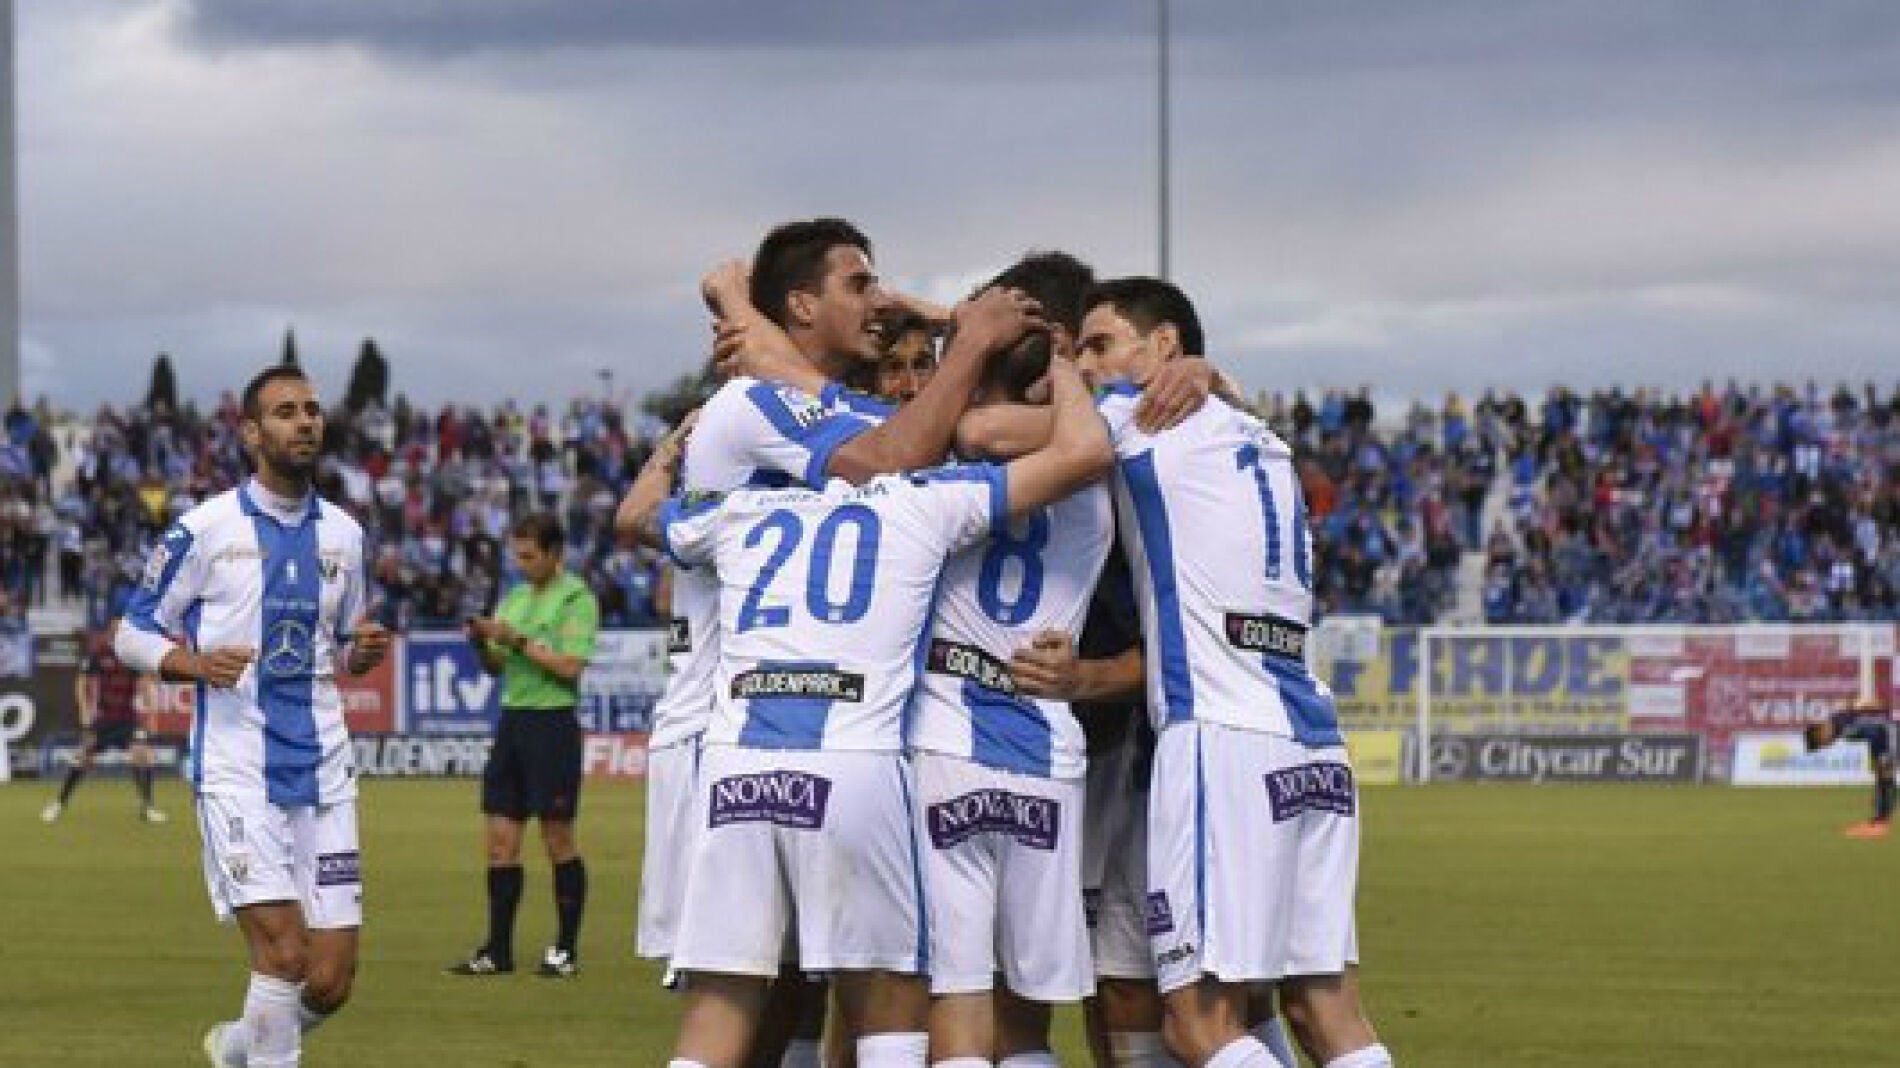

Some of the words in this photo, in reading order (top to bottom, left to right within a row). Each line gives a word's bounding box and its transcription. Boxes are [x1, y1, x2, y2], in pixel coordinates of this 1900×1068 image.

[737, 504, 879, 633] 20
[978, 506, 1049, 625] 8
[413, 654, 495, 713] itv
[1480, 740, 1611, 784] Citycar
[1617, 740, 1684, 774] Sur
